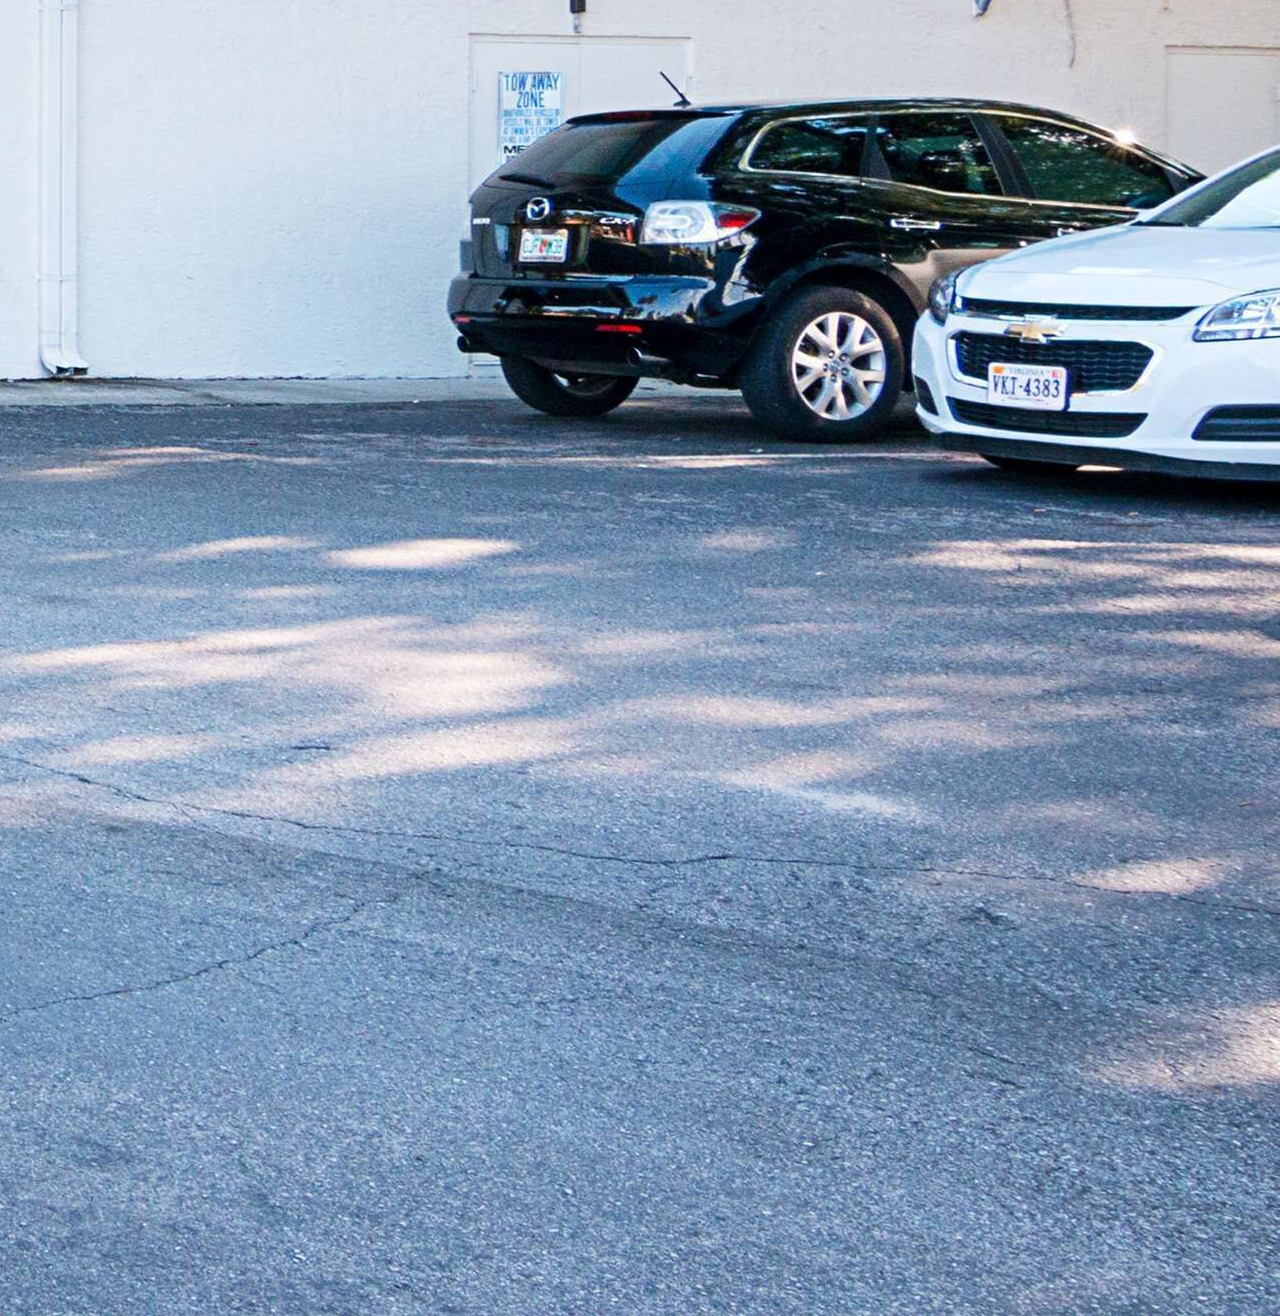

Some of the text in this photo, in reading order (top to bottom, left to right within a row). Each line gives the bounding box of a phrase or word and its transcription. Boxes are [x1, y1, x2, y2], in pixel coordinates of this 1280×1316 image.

[504, 74, 560, 91] TOW AWAY
[516, 91, 545, 108] ZONE
[992, 374, 1060, 398] VKT-4383
